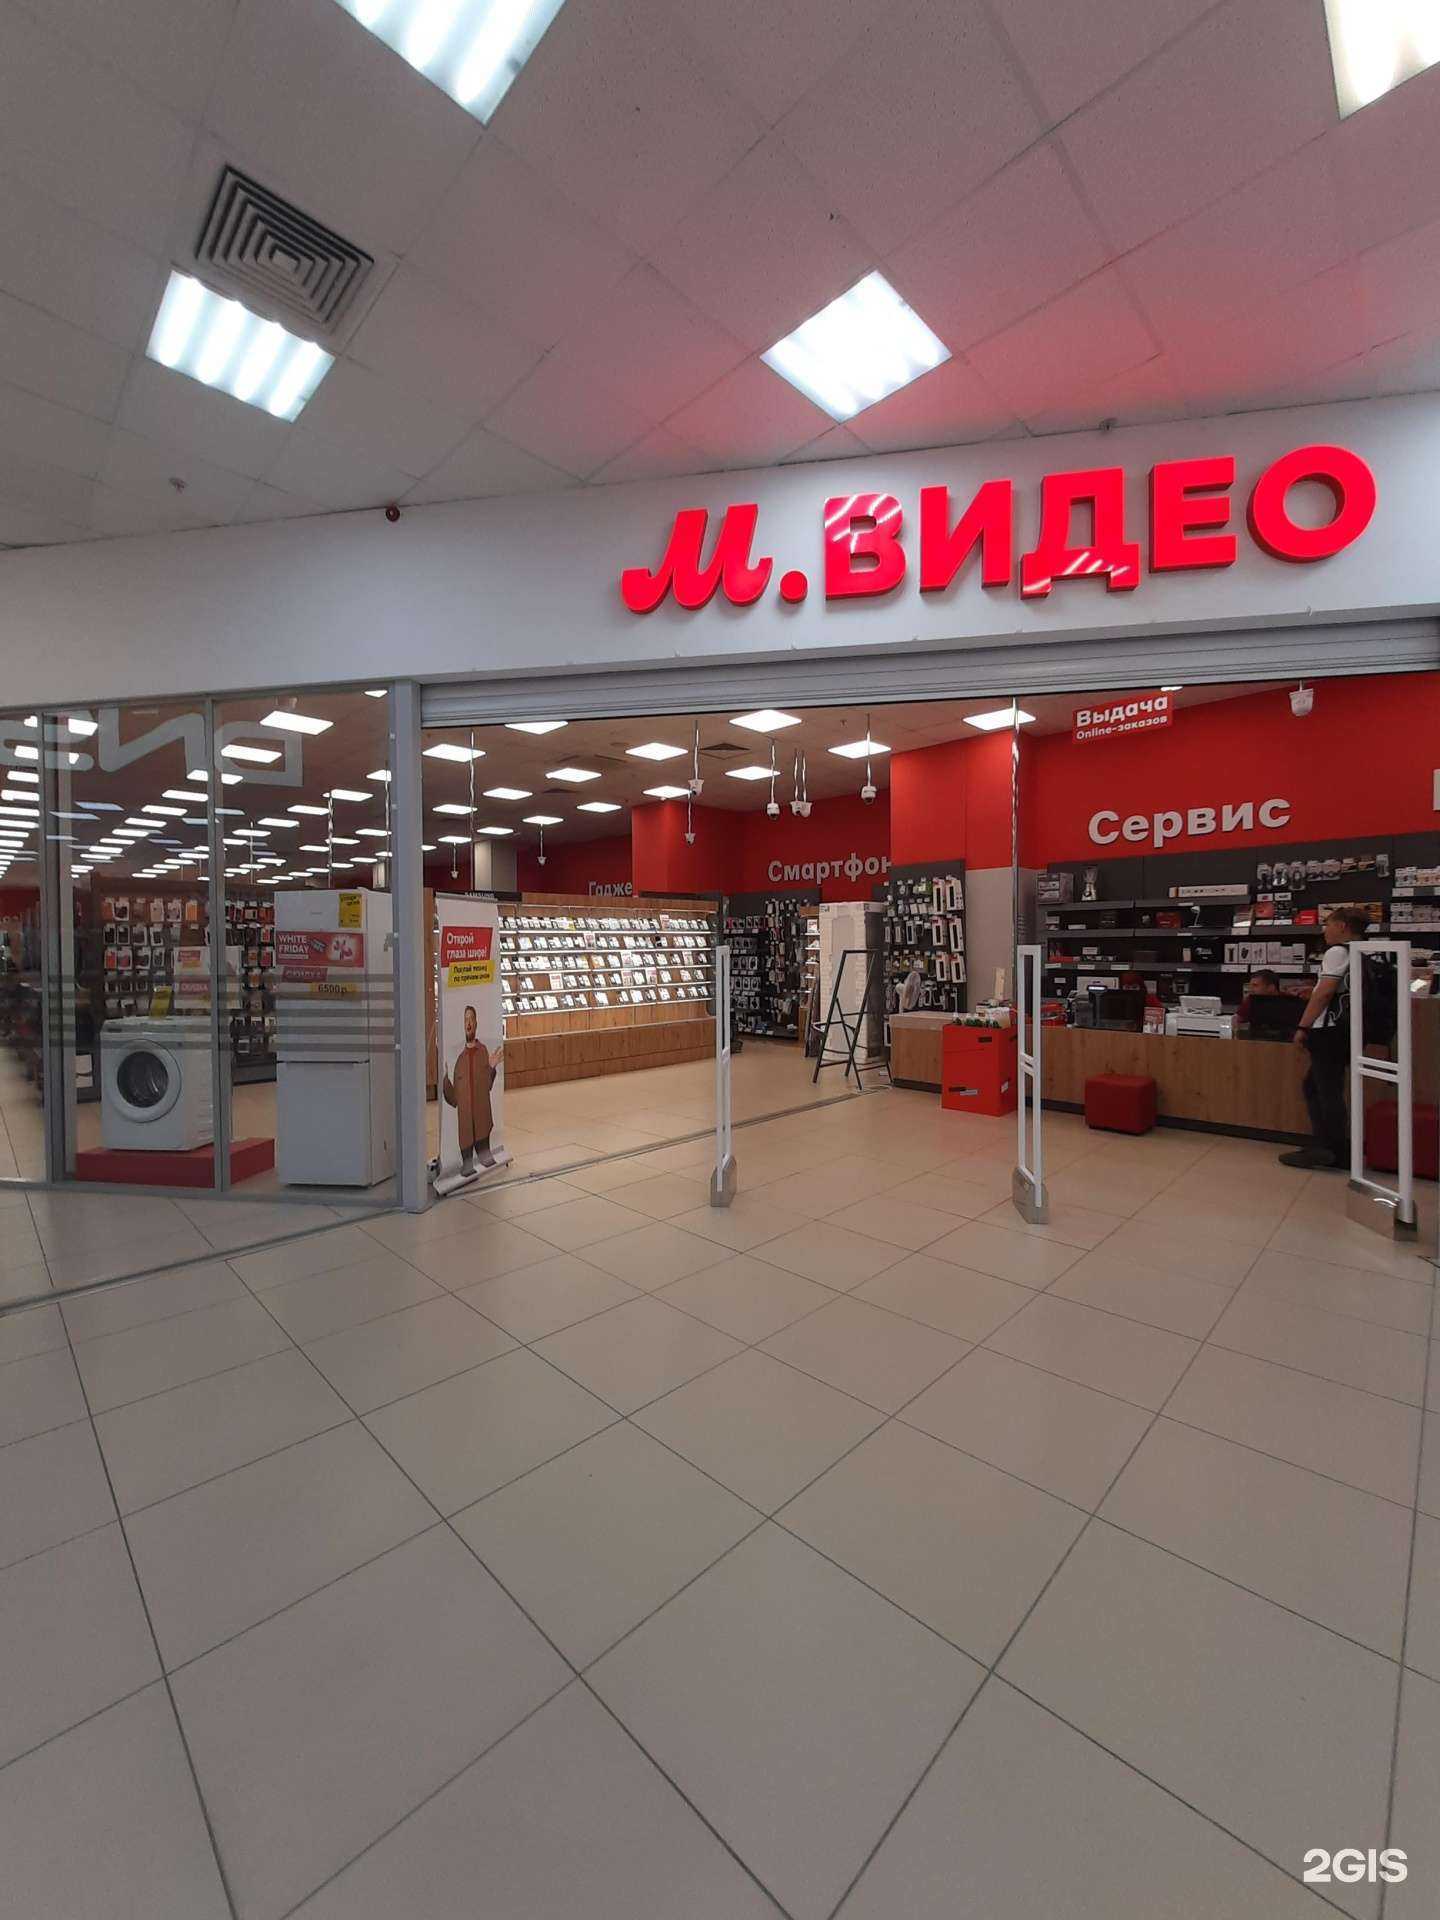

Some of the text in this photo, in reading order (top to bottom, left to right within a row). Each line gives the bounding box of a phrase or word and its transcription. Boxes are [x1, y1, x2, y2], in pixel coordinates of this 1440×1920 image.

[1076, 696, 1168, 728] Выдача
[1076, 715, 1168, 740] Online-заказов
[1088, 798, 1291, 848] Сервис
[278, 934, 307, 944] WHITE
[279, 944, 310, 954] FRIDAY
[446, 932, 474, 947] Открой
